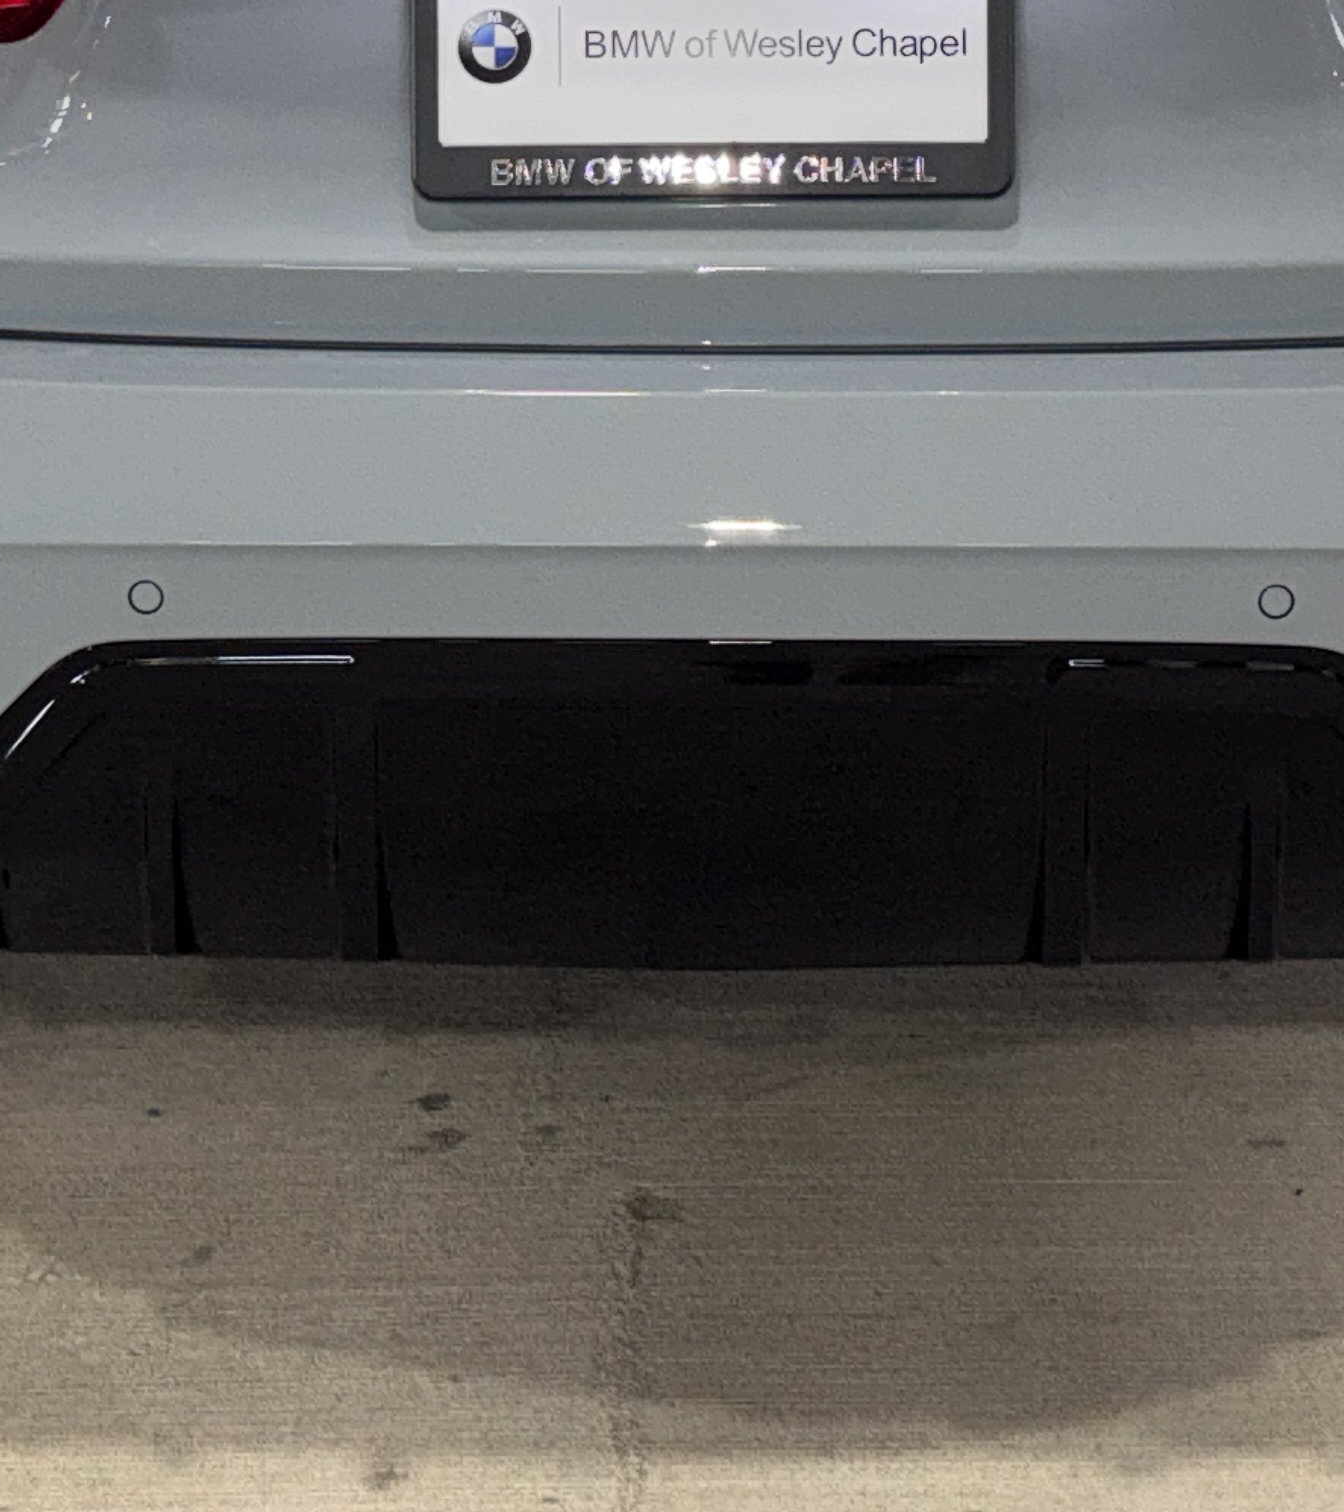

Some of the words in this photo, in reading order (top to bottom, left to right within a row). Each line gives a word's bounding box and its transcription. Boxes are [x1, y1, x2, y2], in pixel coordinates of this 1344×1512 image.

[584, 29, 676, 59] BMW
[684, 29, 719, 59] of
[723, 29, 843, 65] Wesley
[852, 28, 968, 64] Chapel
[490, 159, 575, 186] BMW
[584, 157, 634, 185] OF
[638, 153, 786, 187] WESLEY
[793, 156, 937, 183] CHAPEL
